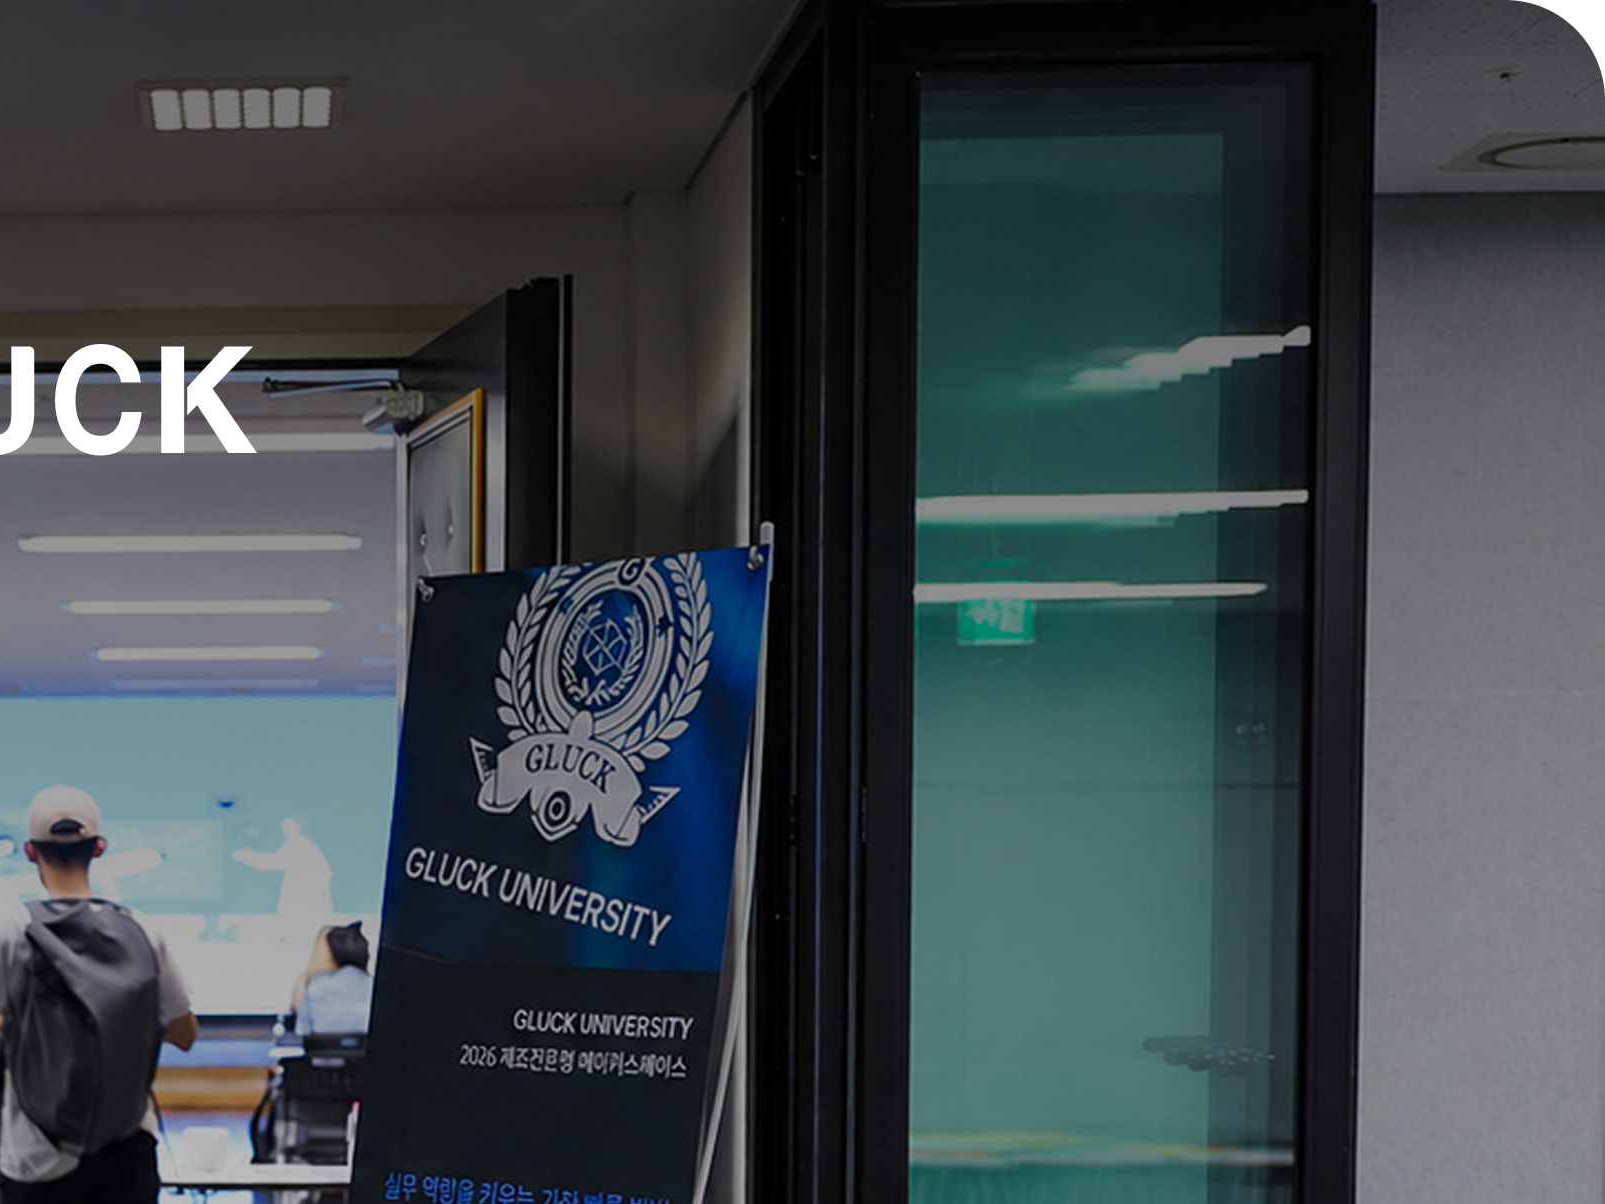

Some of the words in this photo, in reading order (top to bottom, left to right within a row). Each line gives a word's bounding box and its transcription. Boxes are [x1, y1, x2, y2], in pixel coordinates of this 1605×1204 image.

[524, 744, 617, 795] GLUCK
[405, 847, 497, 897] GLUCK
[499, 869, 672, 946] UNIVERSITY
[513, 1008, 578, 1035] GLUCK
[579, 1013, 694, 1040] UNIVERSITY
[459, 1045, 497, 1068] 2026
[383, 1172, 417, 1202] 실무
